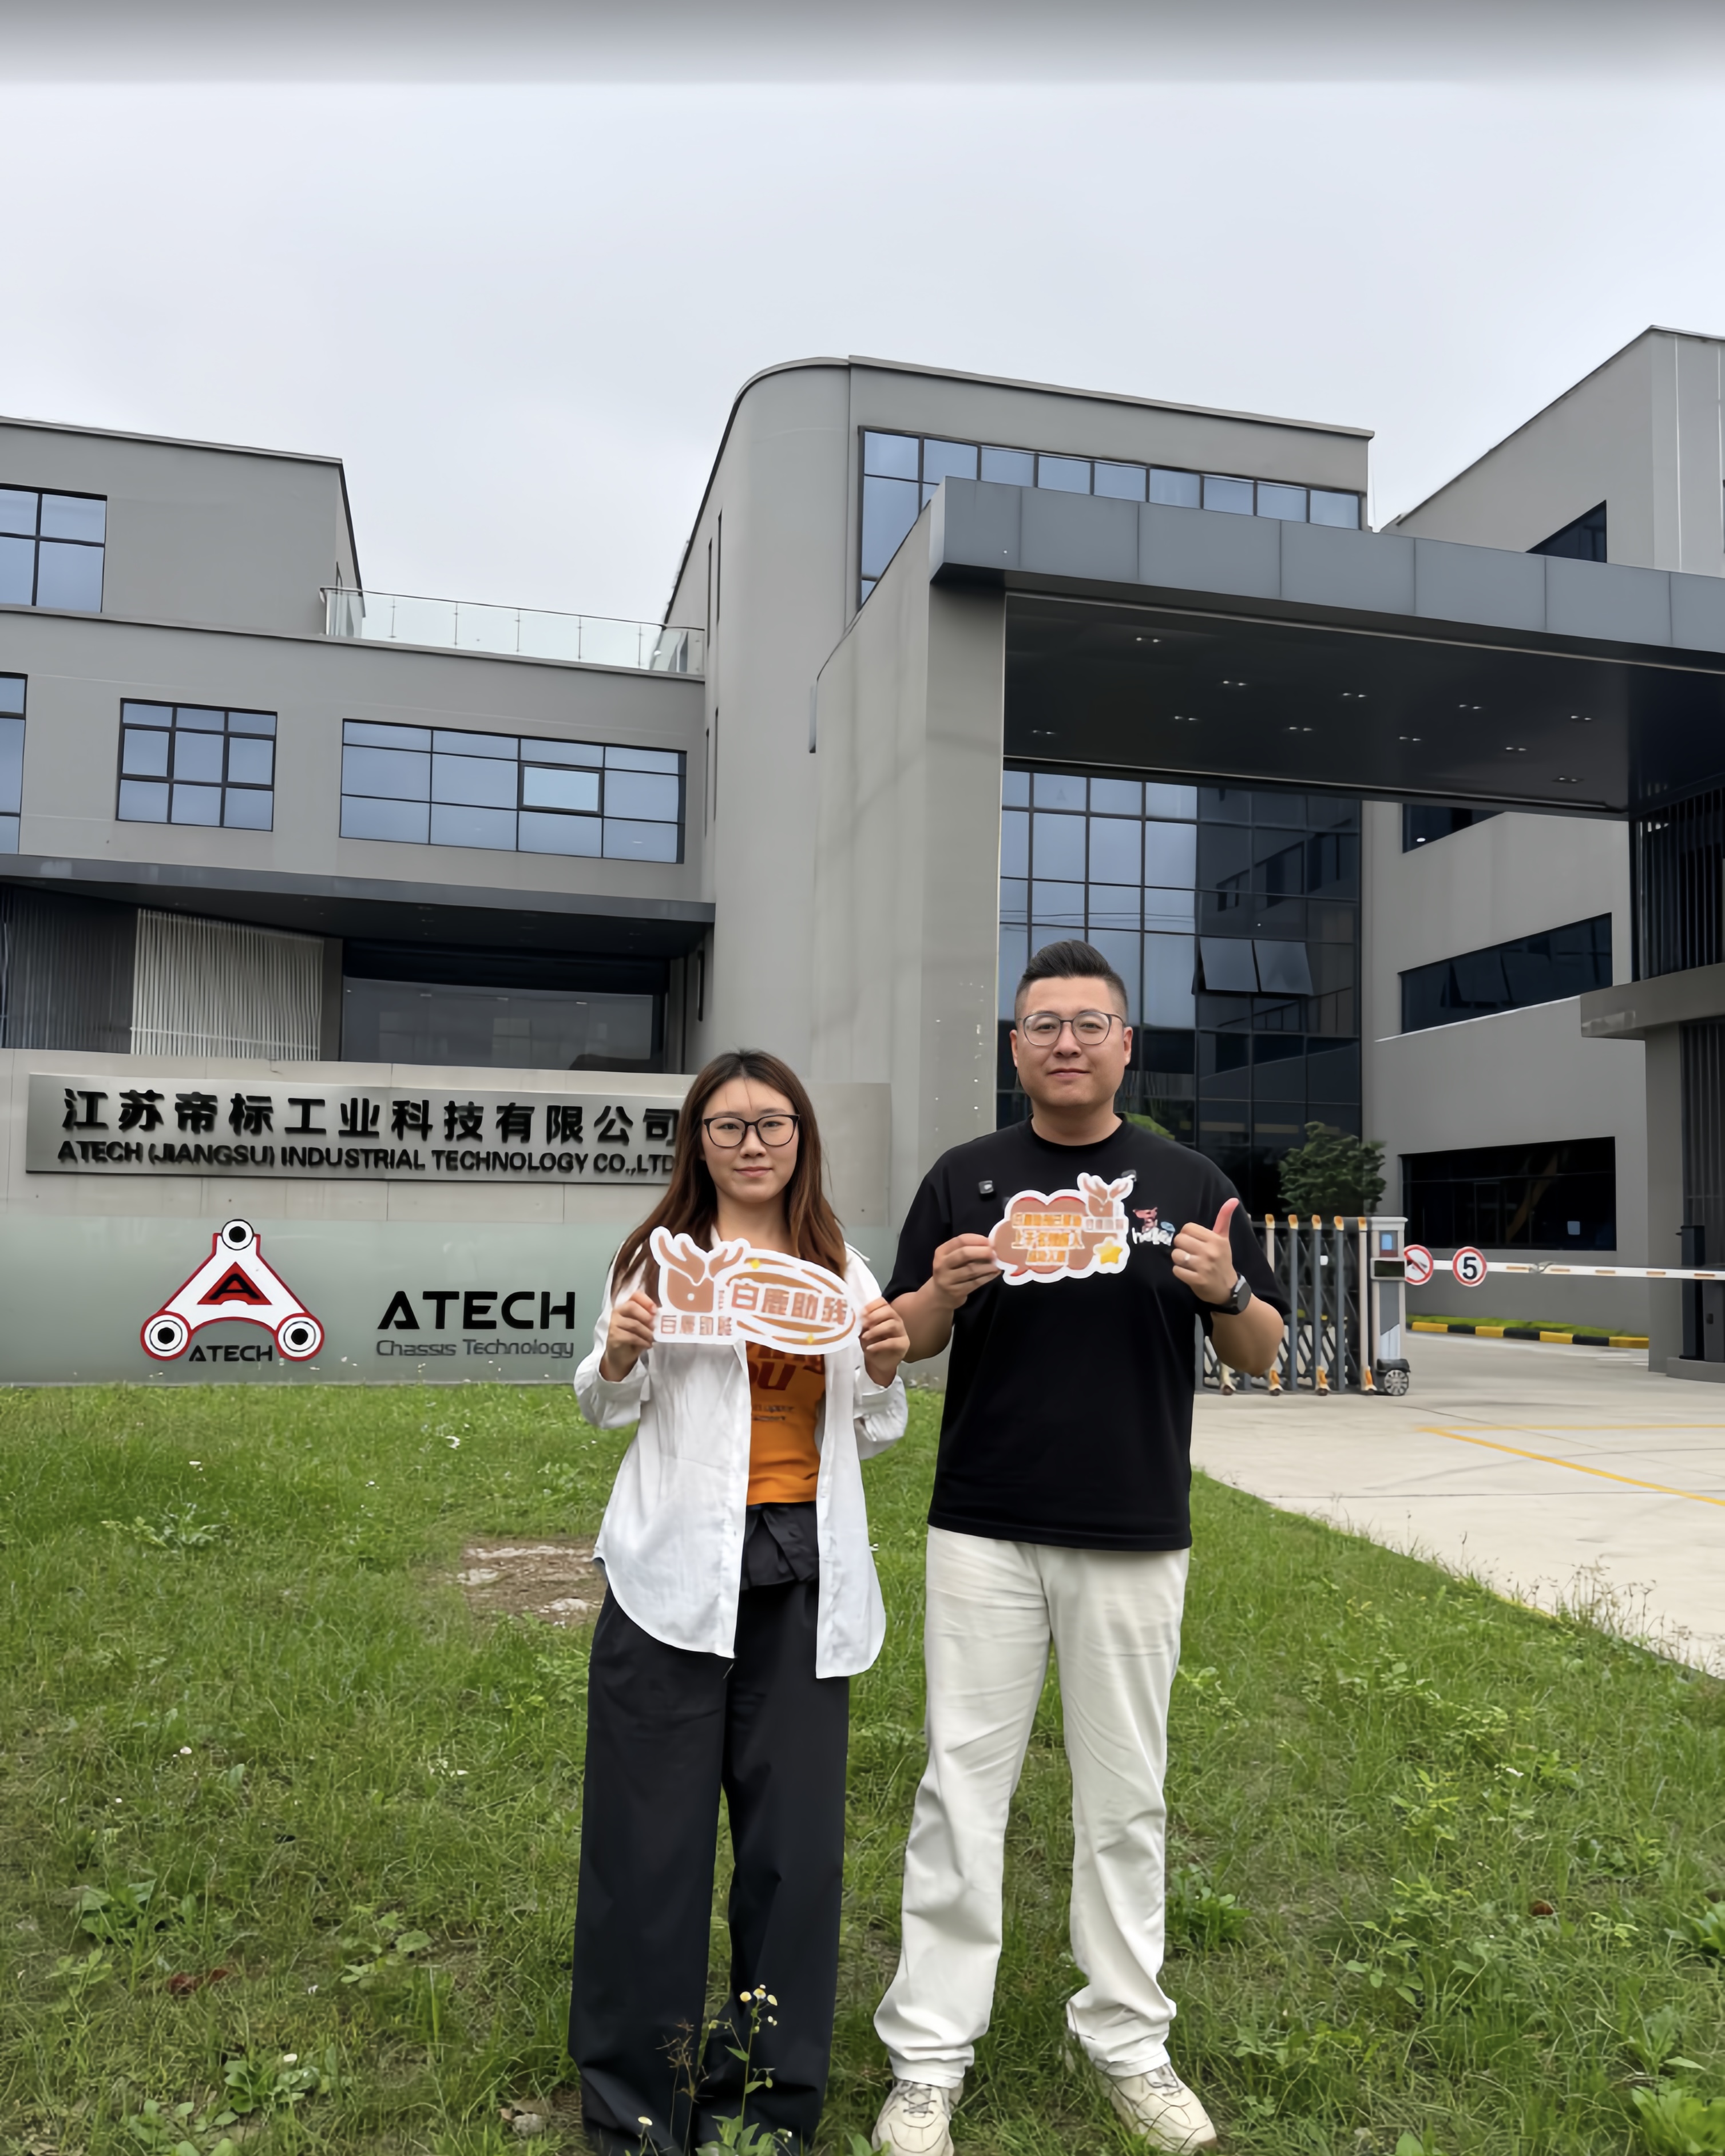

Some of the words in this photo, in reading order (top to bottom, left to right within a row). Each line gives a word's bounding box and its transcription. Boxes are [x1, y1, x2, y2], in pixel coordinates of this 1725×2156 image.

[62, 1088, 679, 1146] 江苏帝标工业科技有限公司
[58, 1141, 143, 1163] ATECH
[148, 1143, 274, 1168] (JIANGSU)
[281, 1146, 426, 1170] INDUSTRIAL
[431, 1150, 588, 1174] TECHNOLOGY
[1462, 1257, 1477, 1280] 5
[377, 1291, 575, 1329] ATECH
[189, 1345, 272, 1362] ATECH
[376, 1340, 457, 1356] Chassis
[462, 1339, 574, 1359] Technology
